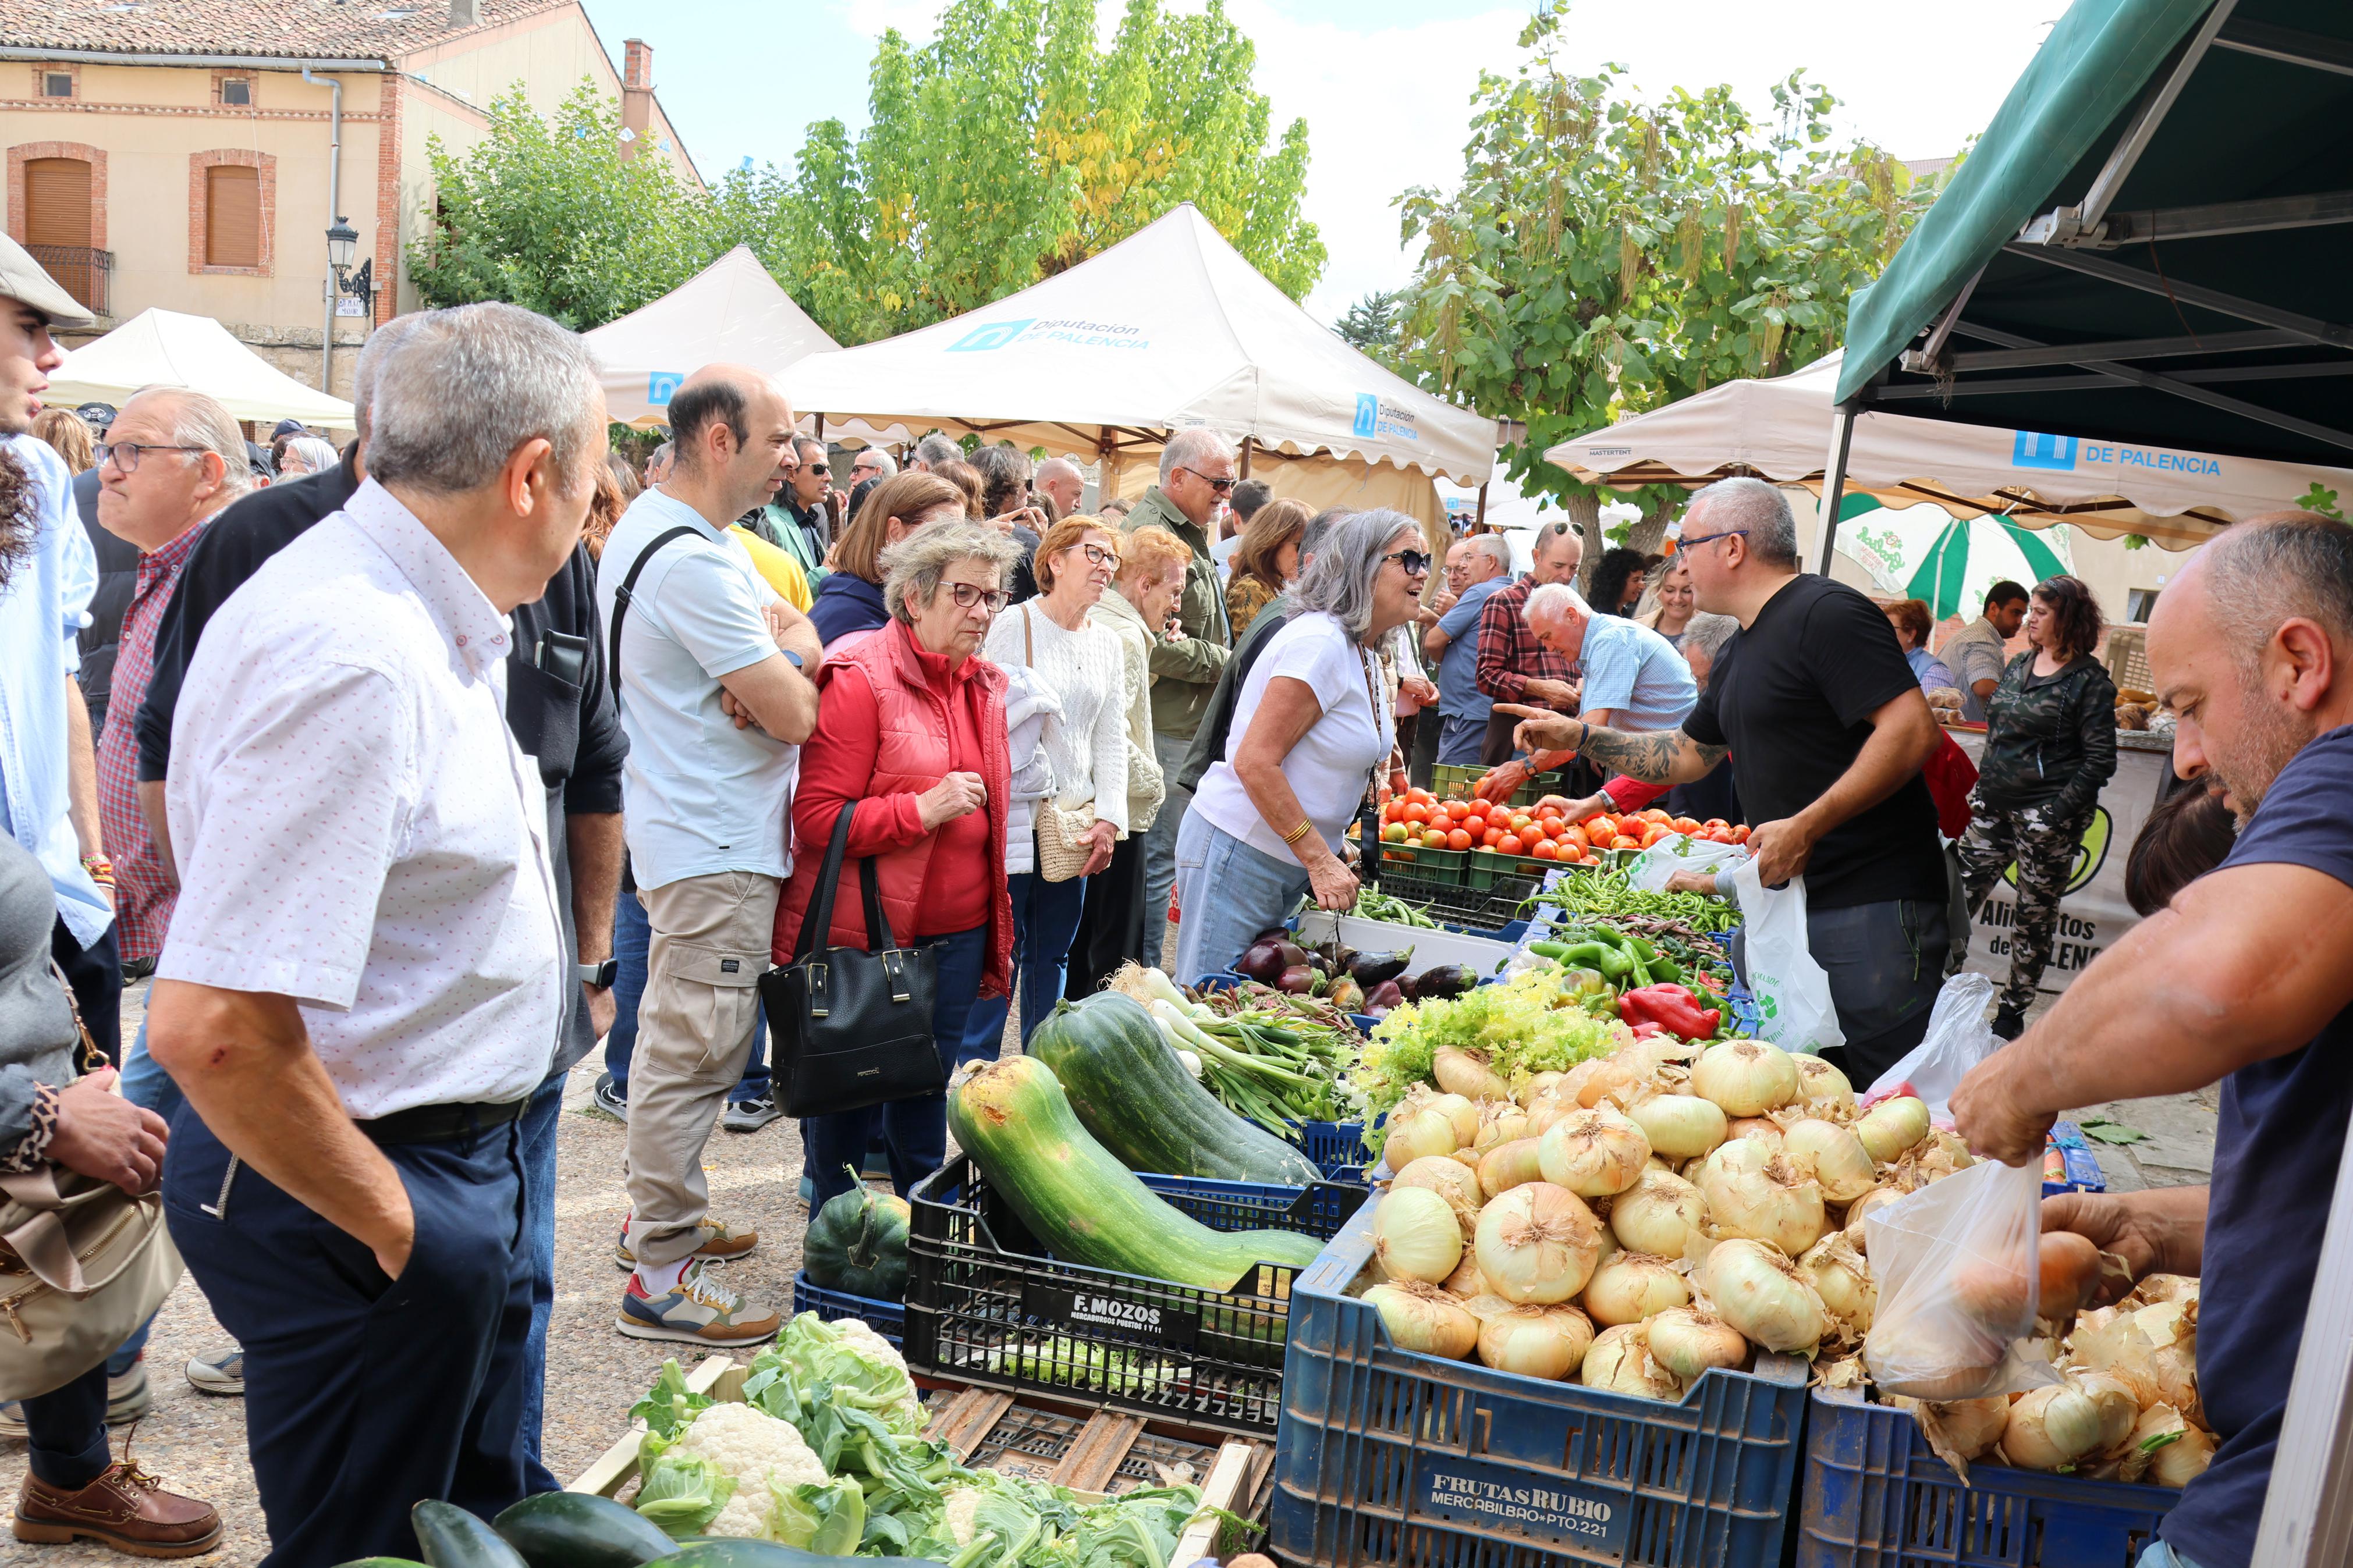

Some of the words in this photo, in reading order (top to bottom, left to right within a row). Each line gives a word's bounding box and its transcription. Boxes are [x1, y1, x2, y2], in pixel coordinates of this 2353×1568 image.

[1032, 318, 1140, 336] Diputación
[1017, 330, 1043, 342] DE
[1046, 330, 1151, 349] PALENCIA
[1379, 404, 1415, 423] Diputación
[1378, 421, 1387, 432] DE
[1389, 423, 1418, 440] PALENCIA
[2086, 446, 2113, 463] DE
[2120, 449, 2221, 477] PALENCIA
[1980, 899, 2096, 940] Alitos
[1990, 935, 2011, 955] de
[1071, 1311, 1115, 1325] MERCABURGOS
[1116, 1318, 1142, 1330] PUESTOS
[1091, 1298, 1160, 1324] MOZOS
[1432, 1474, 1529, 1505] FRUTAS
[1531, 1487, 1612, 1522] RUBIO
